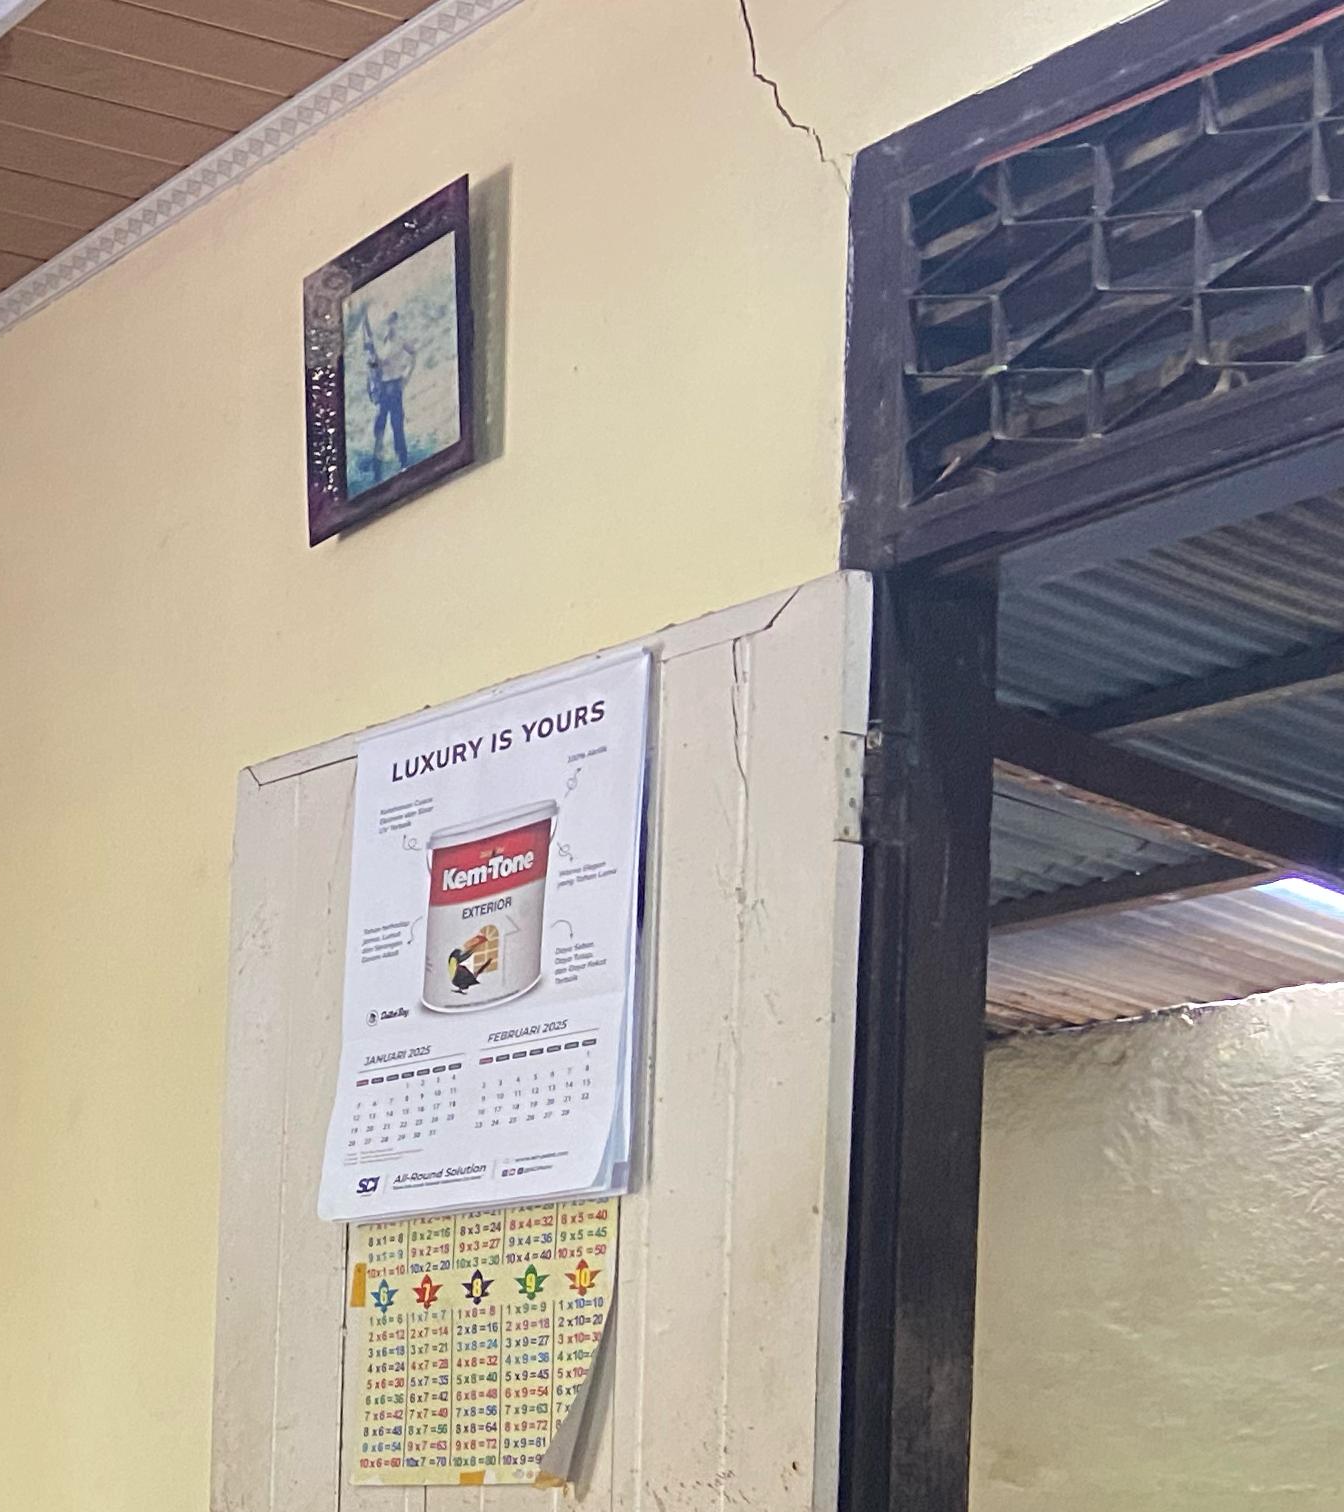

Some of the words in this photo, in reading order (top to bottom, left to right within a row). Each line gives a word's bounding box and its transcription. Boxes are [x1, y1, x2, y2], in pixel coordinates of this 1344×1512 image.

[391, 736, 484, 782] LUXURY
[491, 729, 513, 753] IS
[521, 701, 605, 742] YOURS
[442, 851, 534, 891] Kem-Tone
[462, 896, 512, 919] EXTERIOR
[488, 1024, 542, 1043] FEBRUARI
[543, 1019, 568, 1033] 2025
[364, 1050, 407, 1066] JANUARI
[408, 1045, 432, 1058] 2025
[393, 1169, 443, 1184] All-Round
[445, 1163, 487, 1177] Solution
[526, 1273, 535, 1292] 9
[576, 1268, 590, 1286] 10
[380, 1287, 389, 1305] 6
[422, 1283, 430, 1301] 7
[472, 1279, 482, 1297] 8
